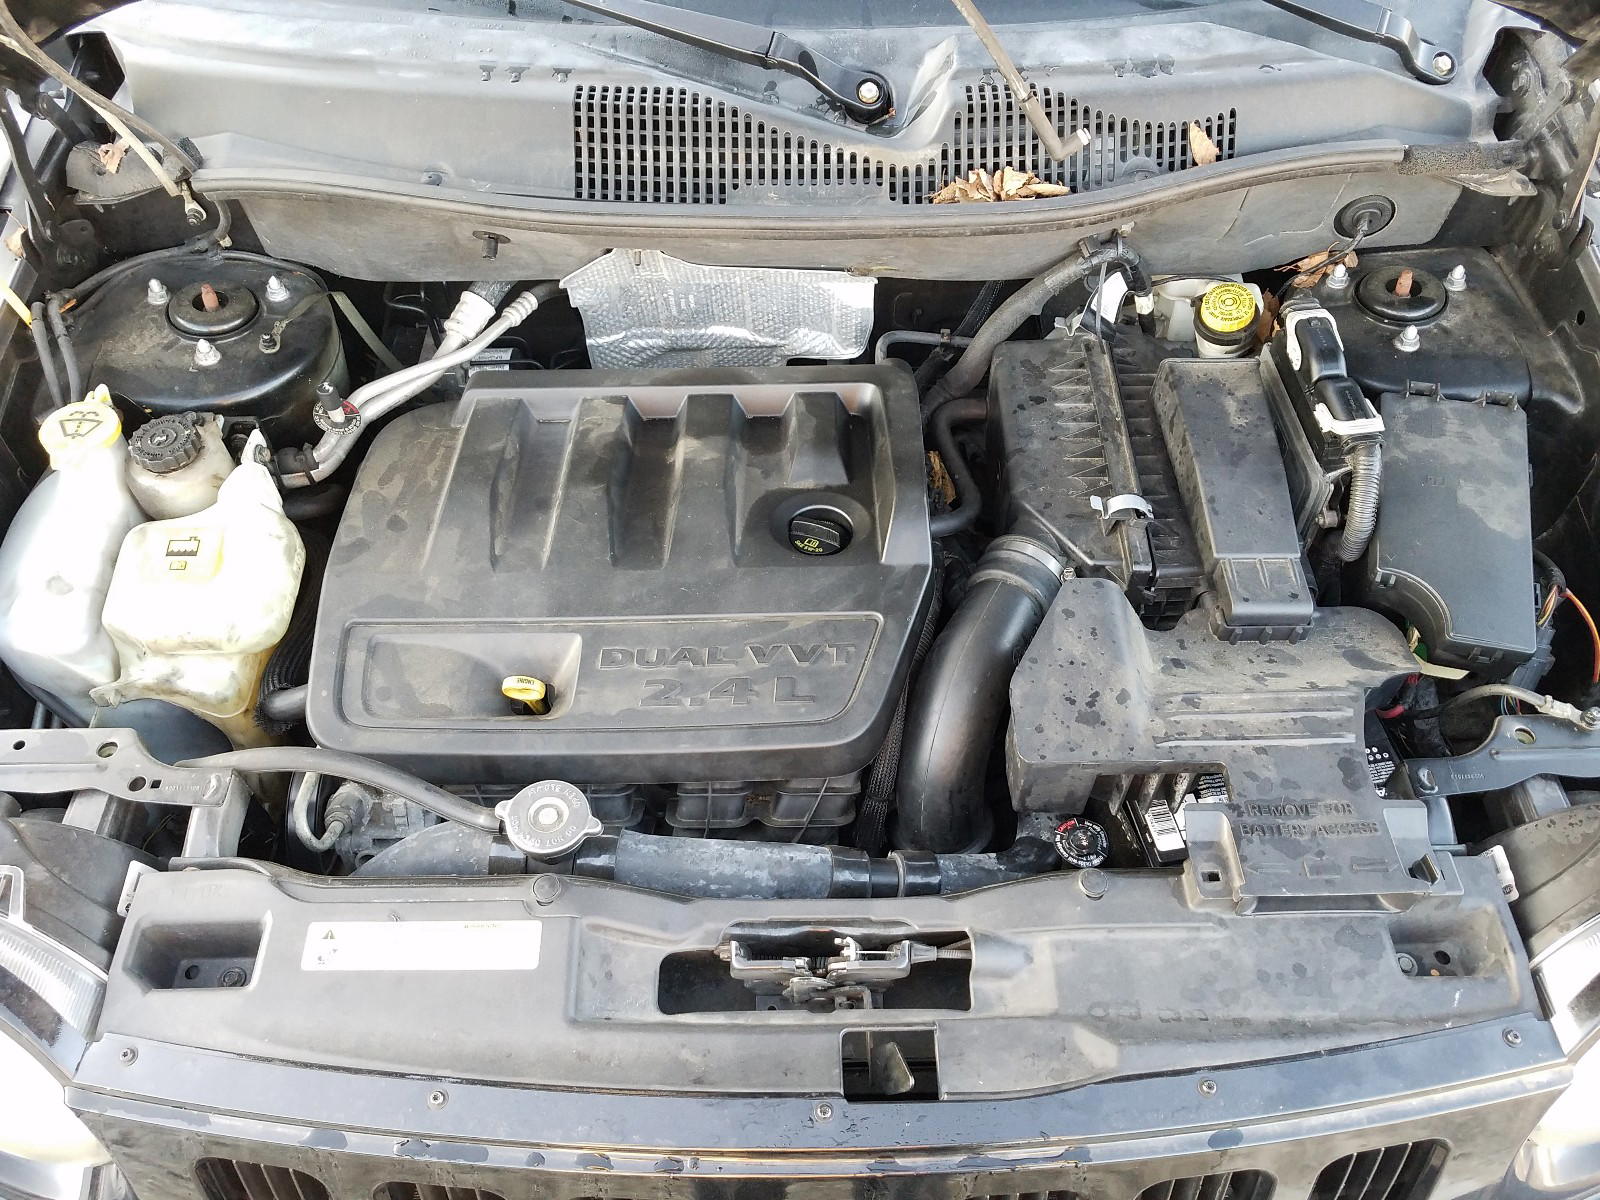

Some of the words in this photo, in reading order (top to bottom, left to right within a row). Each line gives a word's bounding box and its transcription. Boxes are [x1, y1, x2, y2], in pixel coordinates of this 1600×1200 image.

[598, 645, 738, 670] DUAL
[745, 641, 857, 666] VVT
[1248, 801, 1319, 817] REMOVE
[1323, 801, 1354, 816] FOR
[1240, 821, 1308, 838] BATTERY
[1317, 820, 1380, 836] ACCESS
